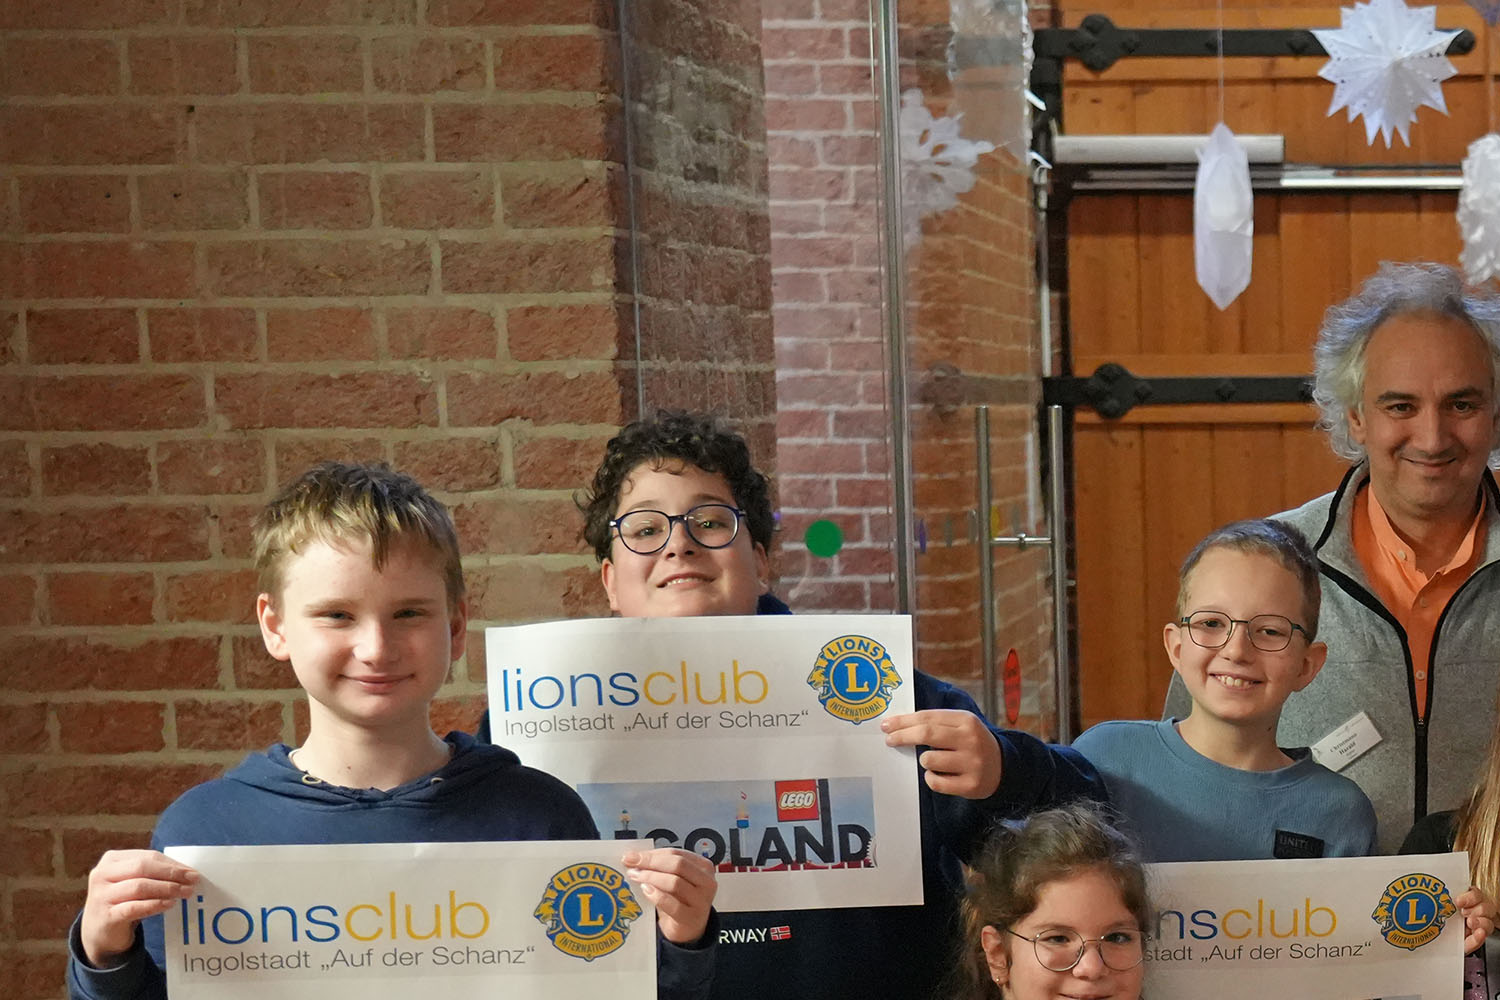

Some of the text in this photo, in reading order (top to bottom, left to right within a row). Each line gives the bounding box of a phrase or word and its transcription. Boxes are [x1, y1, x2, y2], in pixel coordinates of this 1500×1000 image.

[827, 639, 880, 657] LIONS
[502, 660, 769, 712] lionsclub
[830, 701, 883, 717] INTERNATIONAL
[505, 715, 615, 738] Ingolstadt
[623, 713, 669, 733] „Auf
[676, 712, 710, 729] der
[780, 793, 814, 808] LEGO
[557, 867, 618, 888] LIONS
[1391, 877, 1441, 894] LIONS
[182, 890, 490, 945] lionsclub
[559, 935, 619, 953] INTERNATIONAL
[1389, 930, 1436, 945] INTERNATIONAL
[183, 949, 311, 974] Ingolstadt
[320, 946, 374, 971] „Auf
[382, 947, 426, 968] der
[1201, 944, 1243, 963] „Auf
[1249, 944, 1282, 960] der
